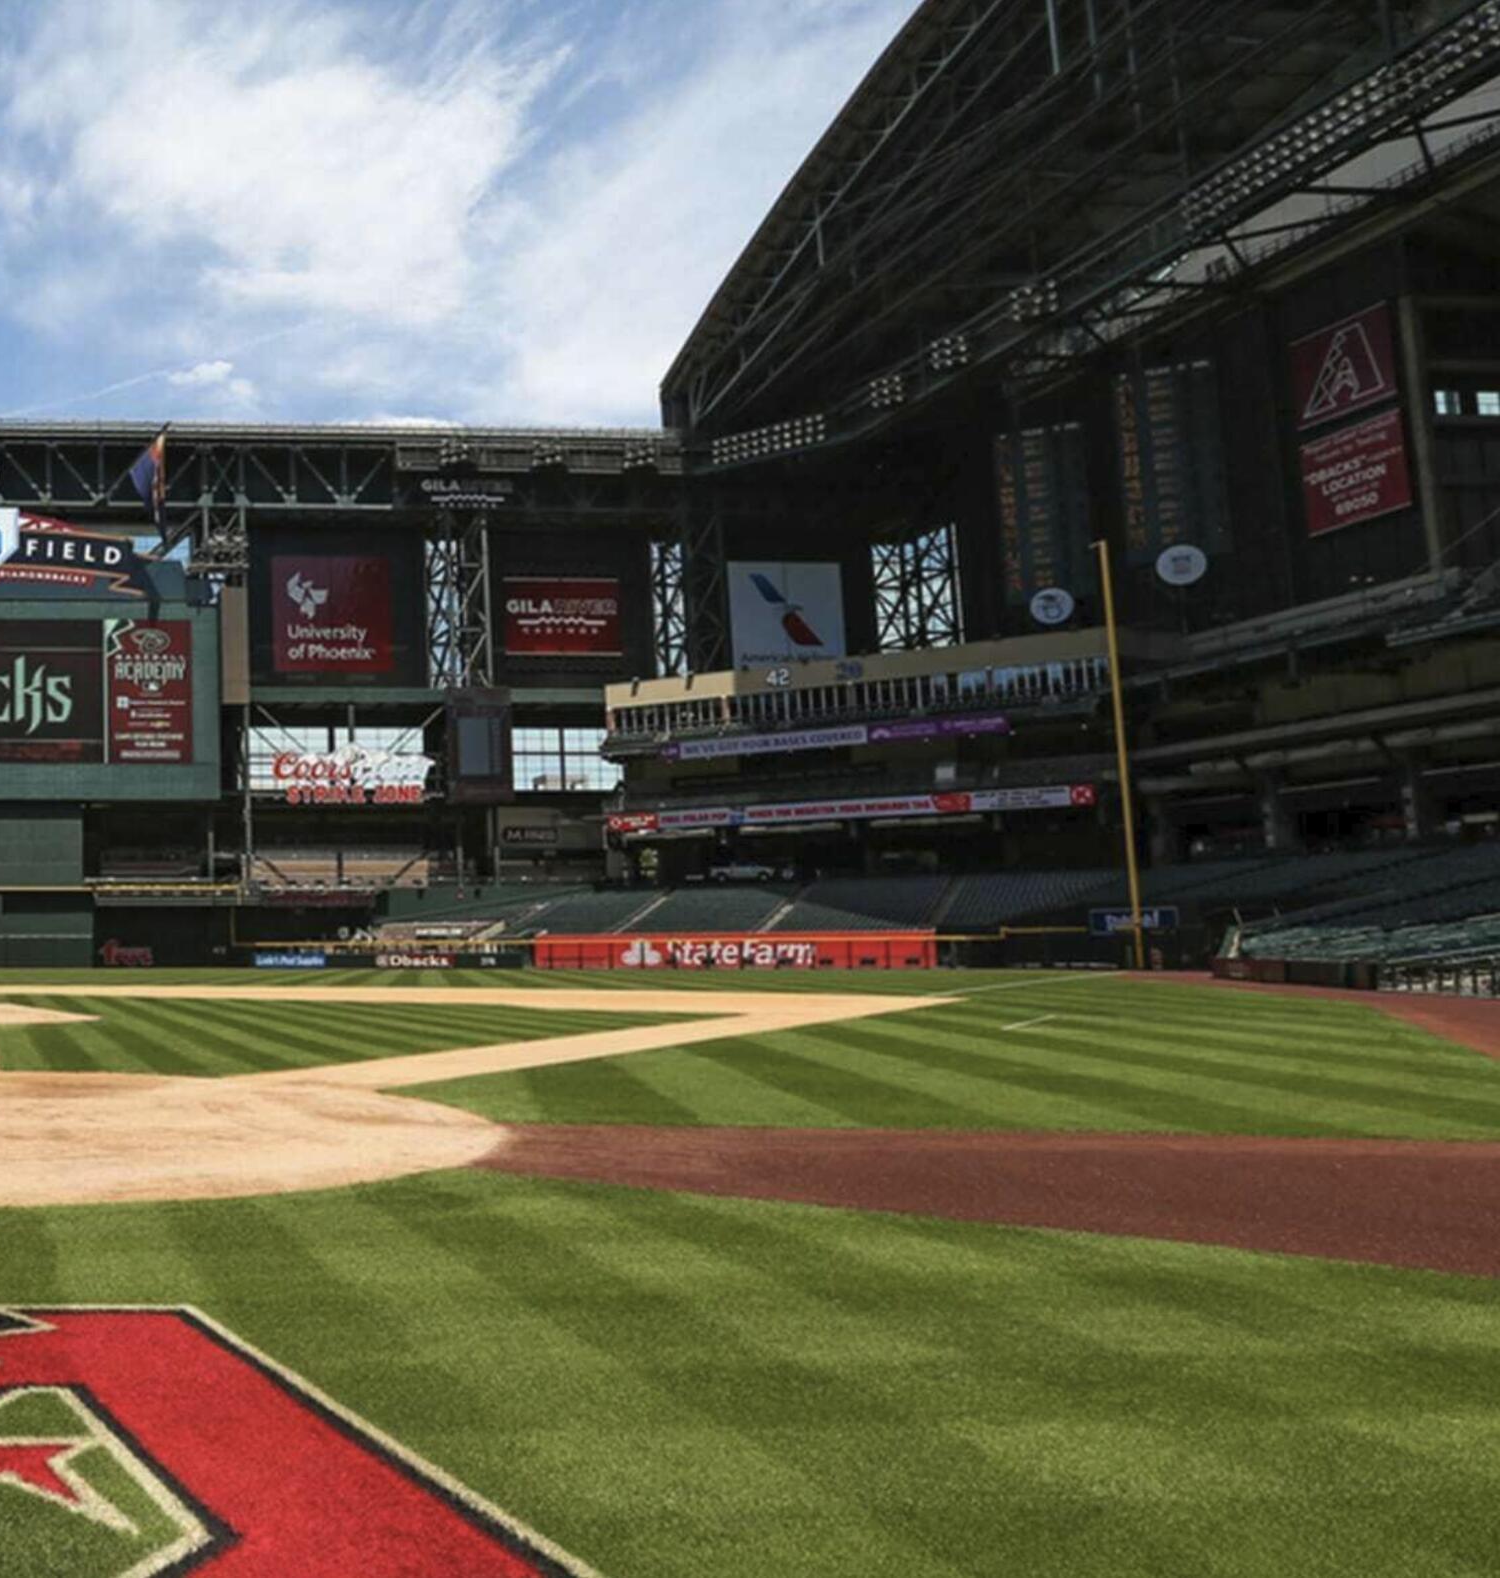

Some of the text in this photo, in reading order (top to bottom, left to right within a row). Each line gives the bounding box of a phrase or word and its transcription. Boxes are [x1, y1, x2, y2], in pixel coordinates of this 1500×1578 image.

[1322, 463, 1387, 497] LOCATION
[26, 538, 122, 565] FIELD
[0, 569, 87, 584] DIAMONDBACKS
[506, 598, 552, 615] GILA
[287, 623, 368, 650] University
[287, 643, 372, 660] of Phoenix
[115, 660, 187, 687] ACADEMY
[765, 668, 790, 687] 42
[809, 730, 864, 744] COVERED
[273, 752, 352, 780] Coors
[372, 784, 424, 805] ZONE
